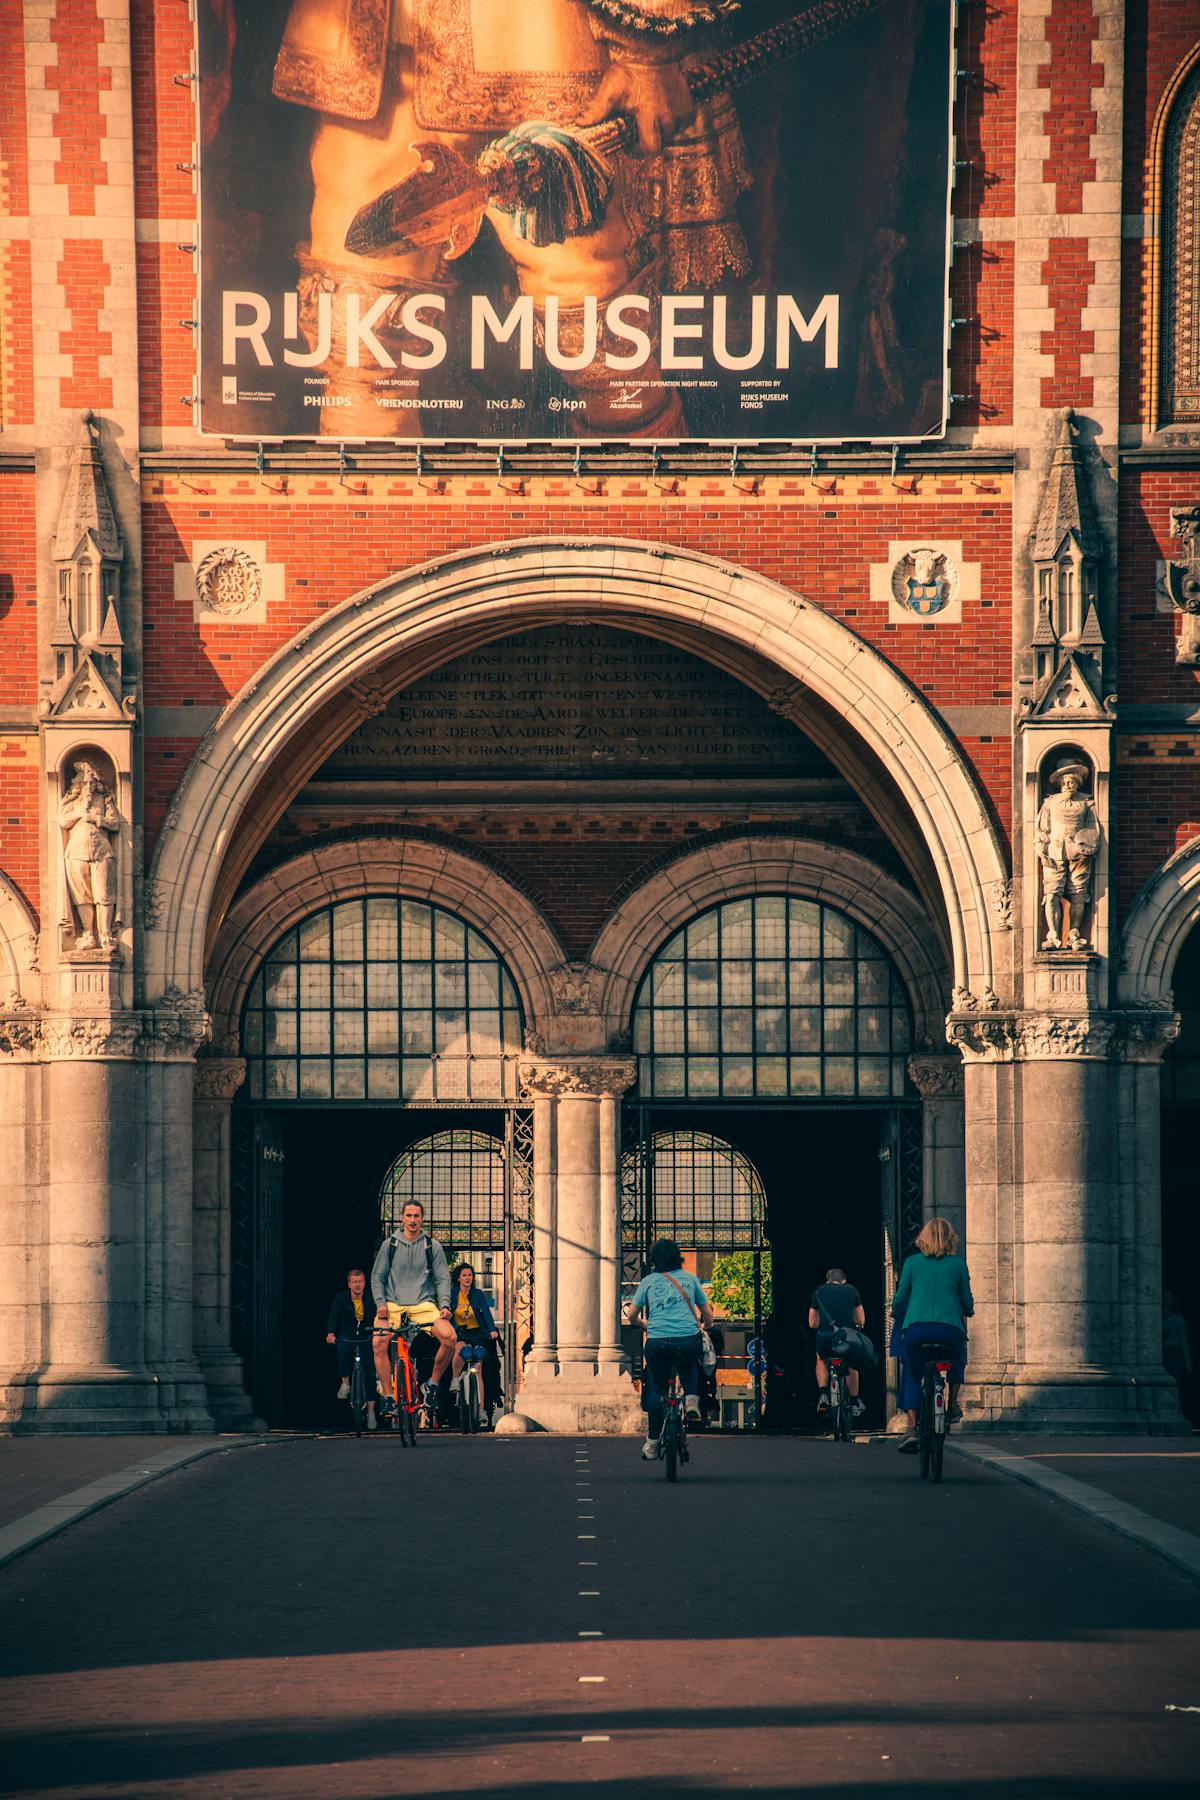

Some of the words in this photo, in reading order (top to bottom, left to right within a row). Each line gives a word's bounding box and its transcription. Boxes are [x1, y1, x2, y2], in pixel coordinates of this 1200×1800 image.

[222, 290, 447, 370] RIJKS
[471, 294, 839, 370] MUSEUM
[303, 396, 353, 407] PHILIPS
[740, 393, 759, 401] RIJKS
[759, 393, 789, 401] MUSEUM
[375, 398, 464, 410] VRIENDENLOTERIJ
[486, 399, 510, 409] ING
[562, 398, 587, 411] kpn
[740, 401, 764, 409] FONDS
